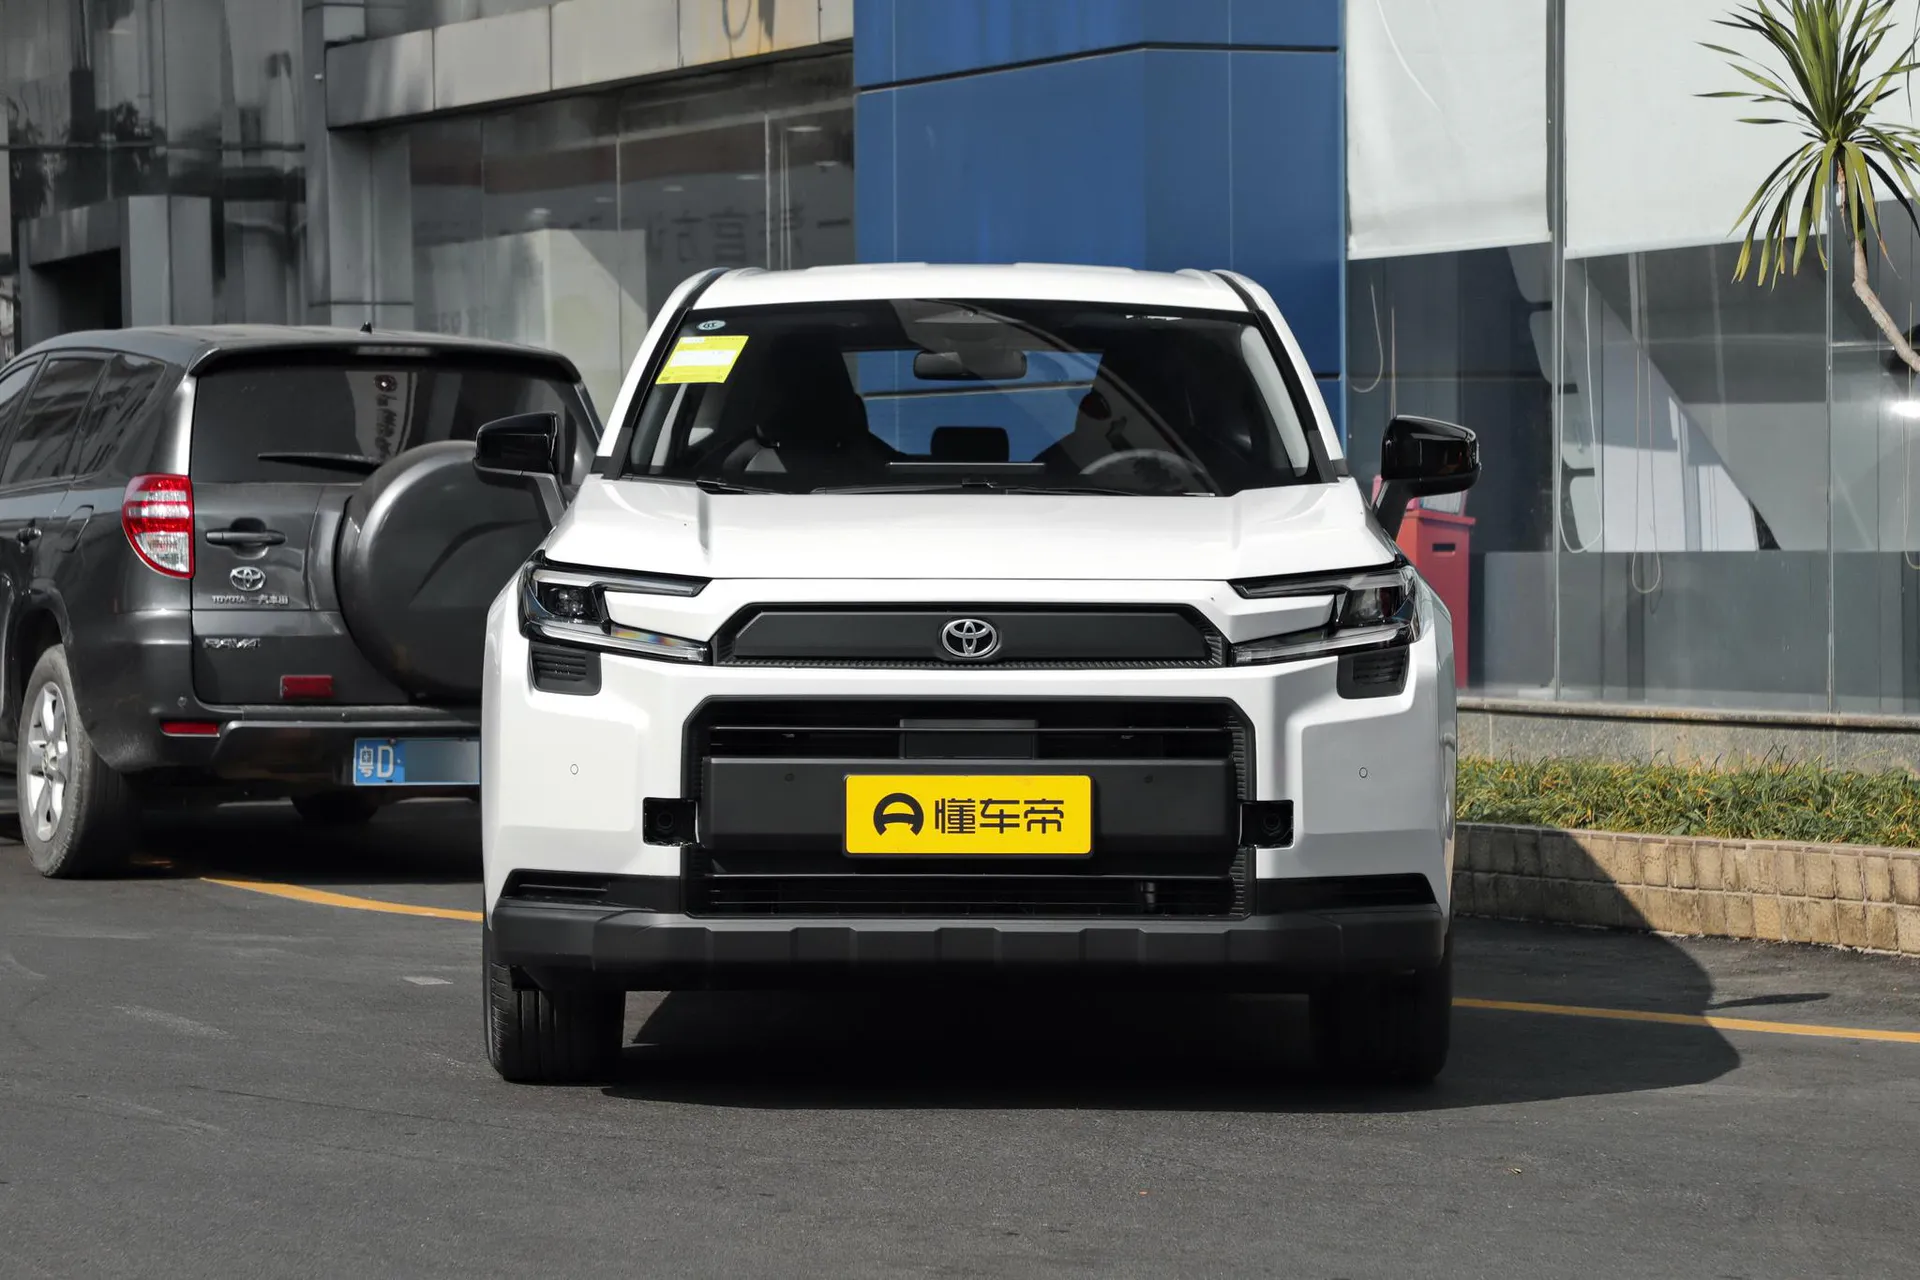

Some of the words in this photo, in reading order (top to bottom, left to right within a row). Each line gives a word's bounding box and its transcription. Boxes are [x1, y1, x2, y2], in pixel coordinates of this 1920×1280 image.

[211, 594, 246, 604] TOYOTA
[203, 638, 261, 649] RAV4
[934, 797, 1065, 835] 懂车帝
